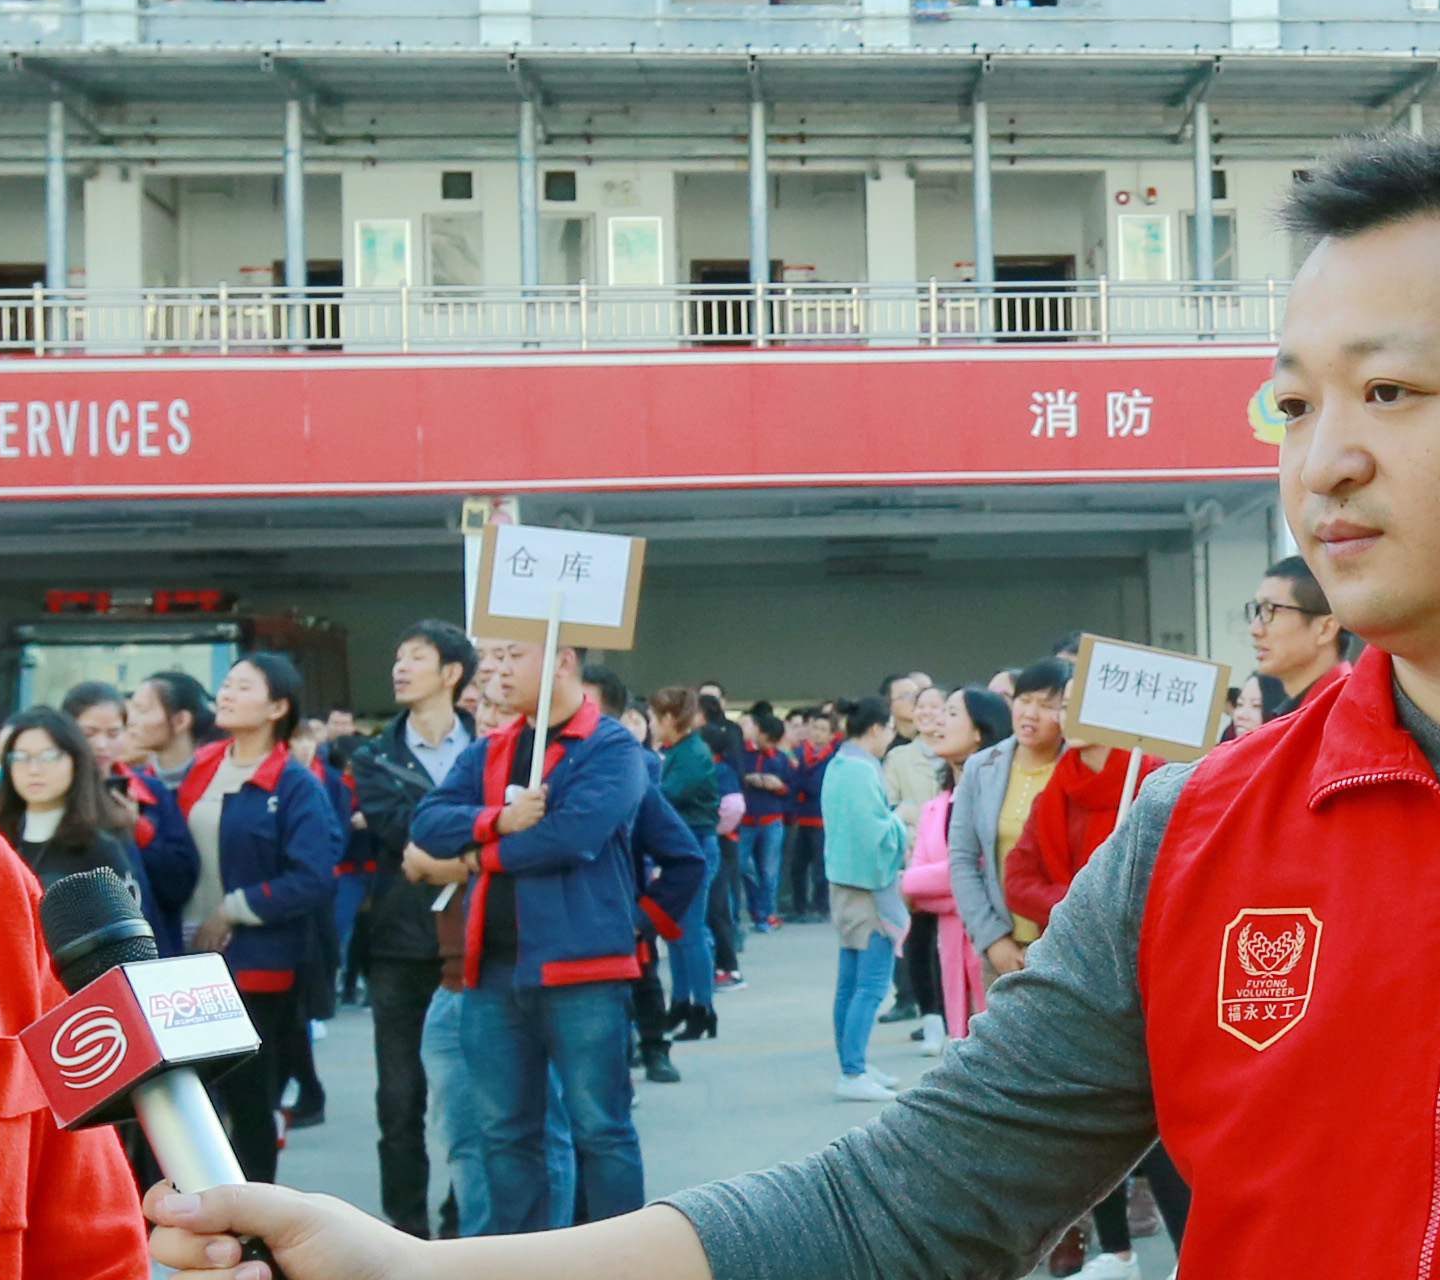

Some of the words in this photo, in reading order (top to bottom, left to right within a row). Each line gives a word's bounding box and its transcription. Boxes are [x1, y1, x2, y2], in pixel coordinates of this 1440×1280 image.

[1029, 389, 1153, 438] 消防
[506, 546, 593, 583] 仓库
[1098, 661, 1198, 707] 物料部
[1236, 987, 1295, 998] VOLUNTEER
[1245, 979, 1288, 989] FUYONG
[1227, 1003, 1295, 1022] 福永义工
